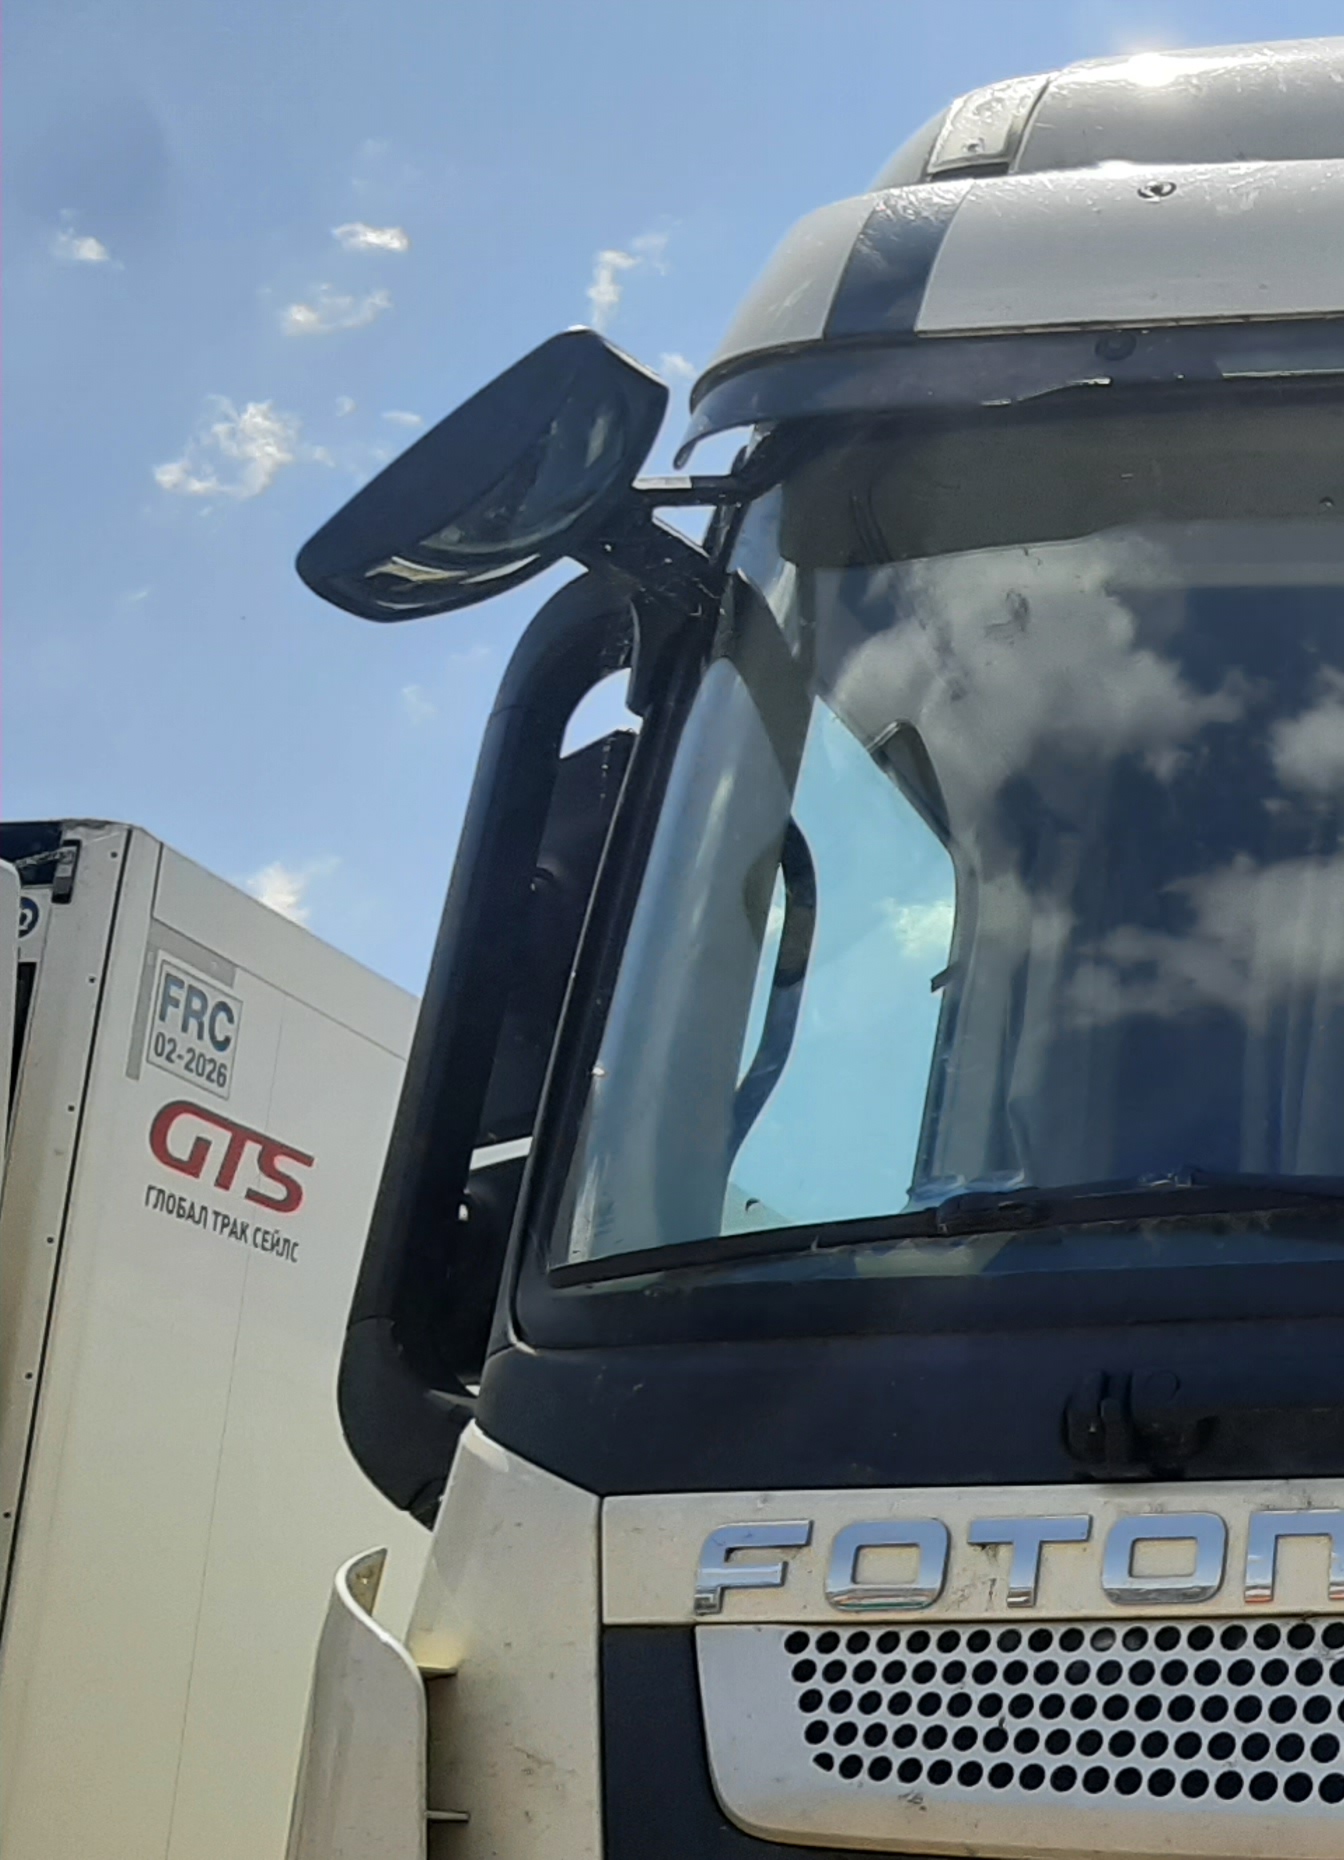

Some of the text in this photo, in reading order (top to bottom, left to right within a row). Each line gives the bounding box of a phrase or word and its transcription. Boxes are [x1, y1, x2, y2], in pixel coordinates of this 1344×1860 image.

[159, 972, 235, 1052] FRC
[154, 1031, 228, 1088] 02-2026
[149, 1099, 315, 1214] GTS
[145, 1184, 299, 1264] ГЛОБАЛ ТРАК СЕЙЛС
